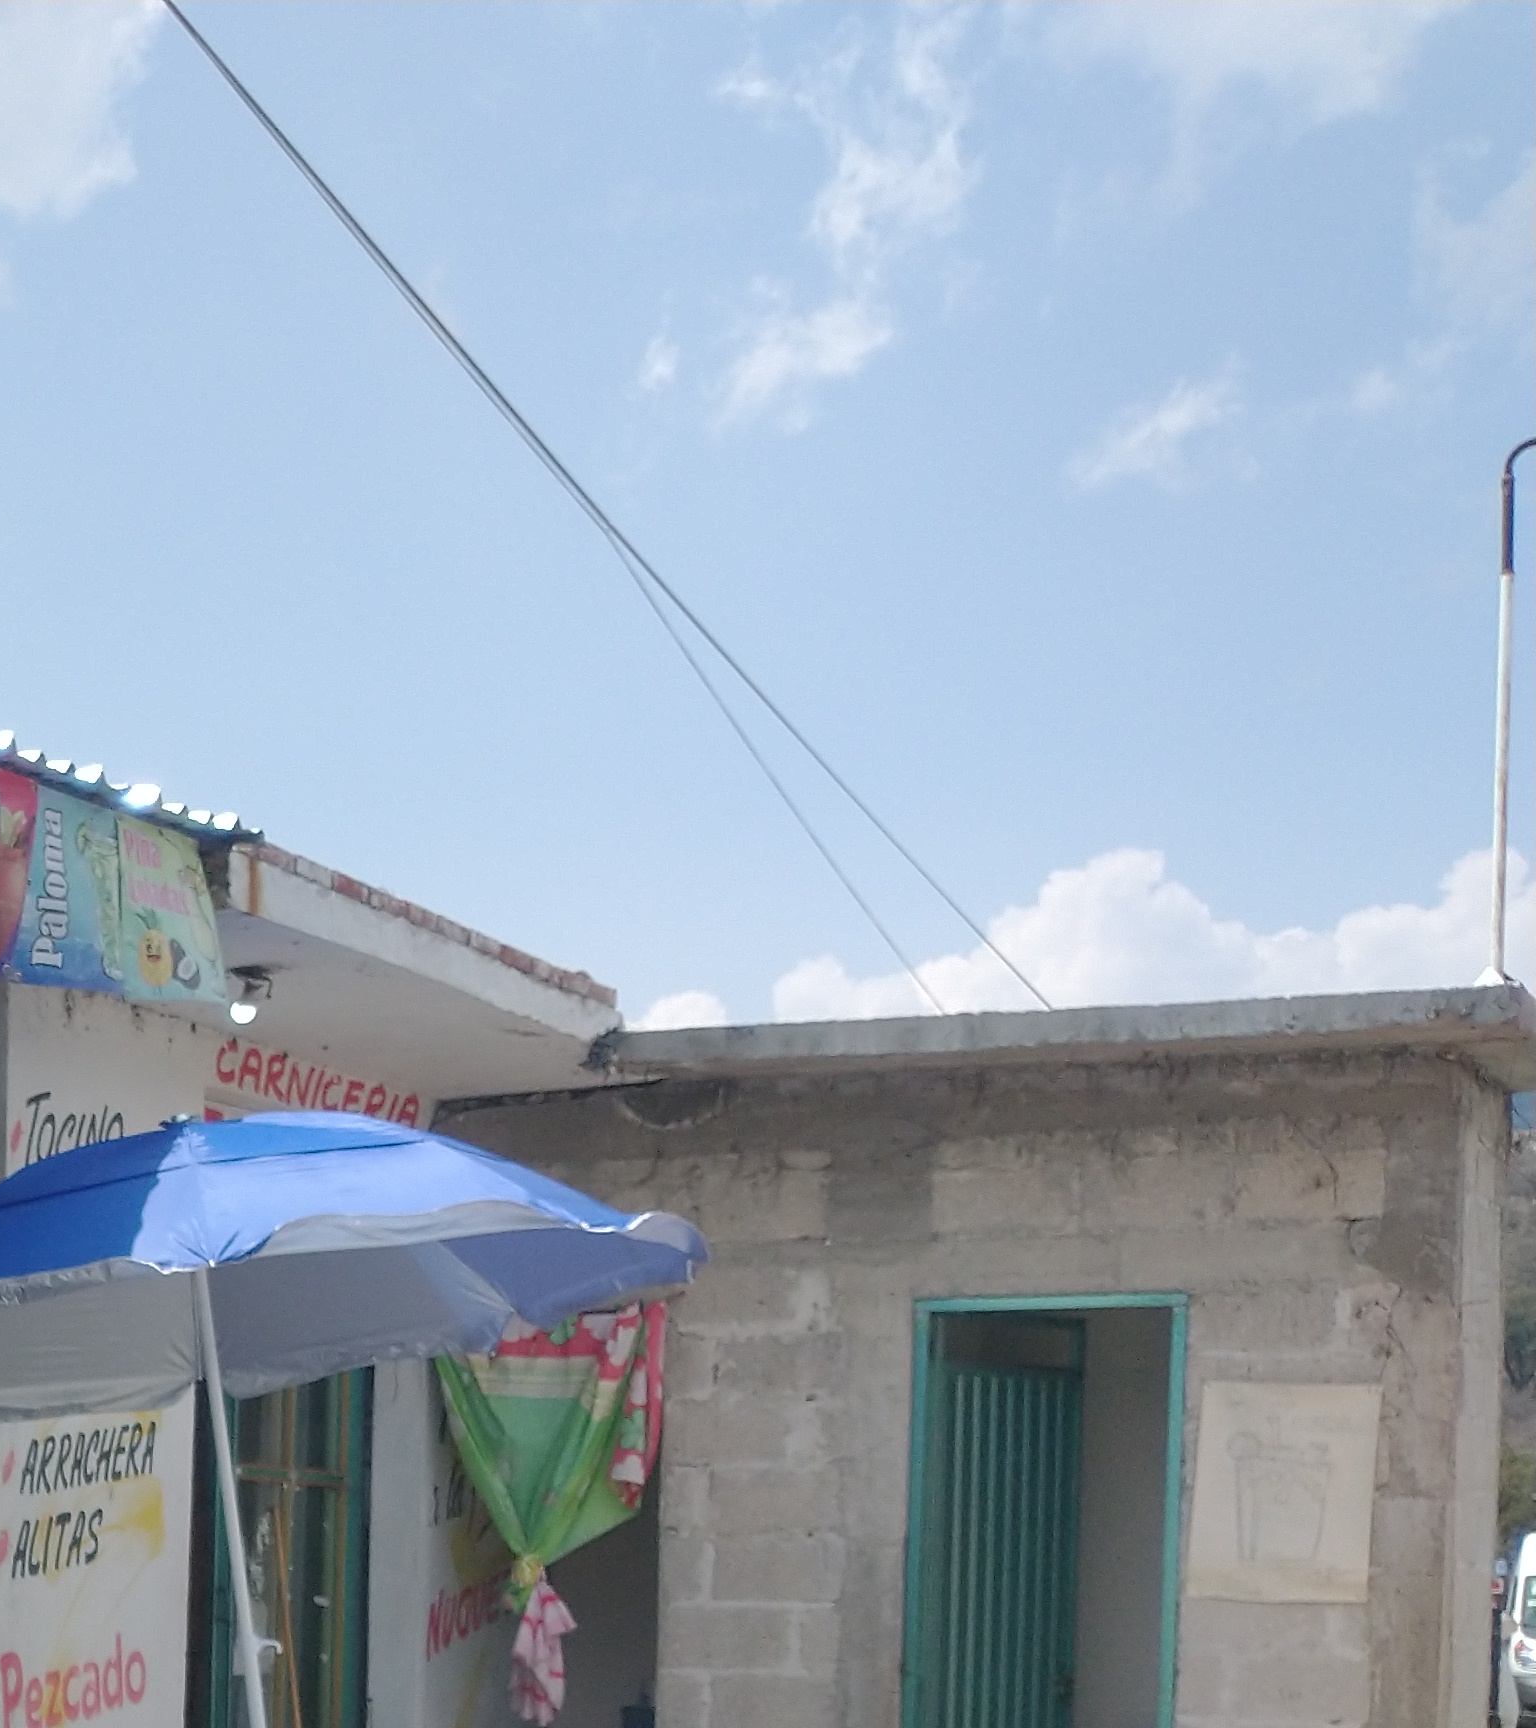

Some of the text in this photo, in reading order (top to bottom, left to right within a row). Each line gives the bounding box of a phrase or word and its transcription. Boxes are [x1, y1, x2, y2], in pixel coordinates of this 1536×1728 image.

[34, 807, 70, 970] Paloma
[215, 1038, 421, 1129] CARNICERIA
[19, 1420, 158, 1495] ARRACHERA
[11, 1507, 105, 1580] ALITAS
